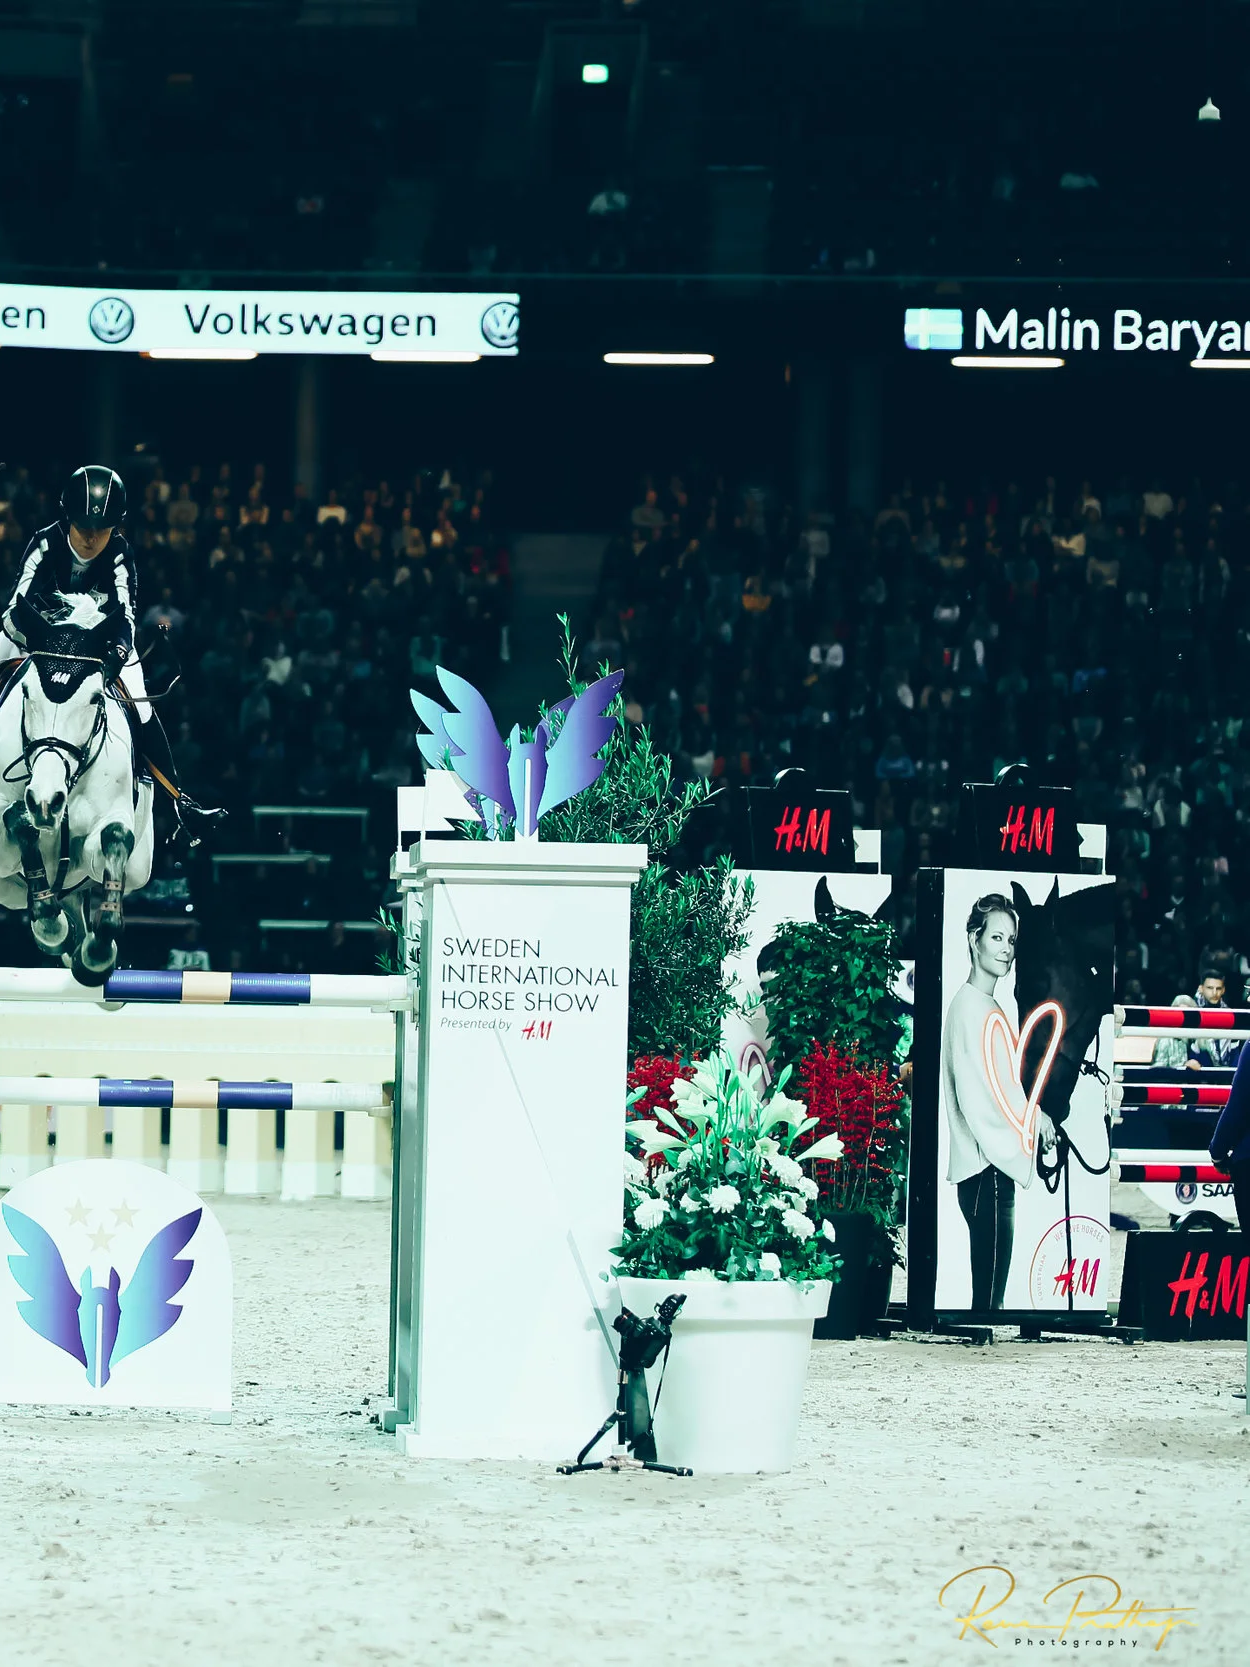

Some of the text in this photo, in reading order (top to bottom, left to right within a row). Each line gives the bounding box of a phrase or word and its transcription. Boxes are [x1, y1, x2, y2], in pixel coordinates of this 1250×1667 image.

[184, 303, 436, 345] Volkswagen
[975, 307, 1100, 351] Malin
[774, 806, 831, 856] H&M
[1000, 804, 1056, 856] H&M
[442, 937, 541, 958] SWEDEN
[442, 963, 619, 987] INTERNATIONAL
[441, 990, 600, 1012] HORSE SHOW
[440, 1017, 496, 1029] Presented
[498, 1018, 512, 1032] by
[1167, 1251, 1250, 1319] H&M
